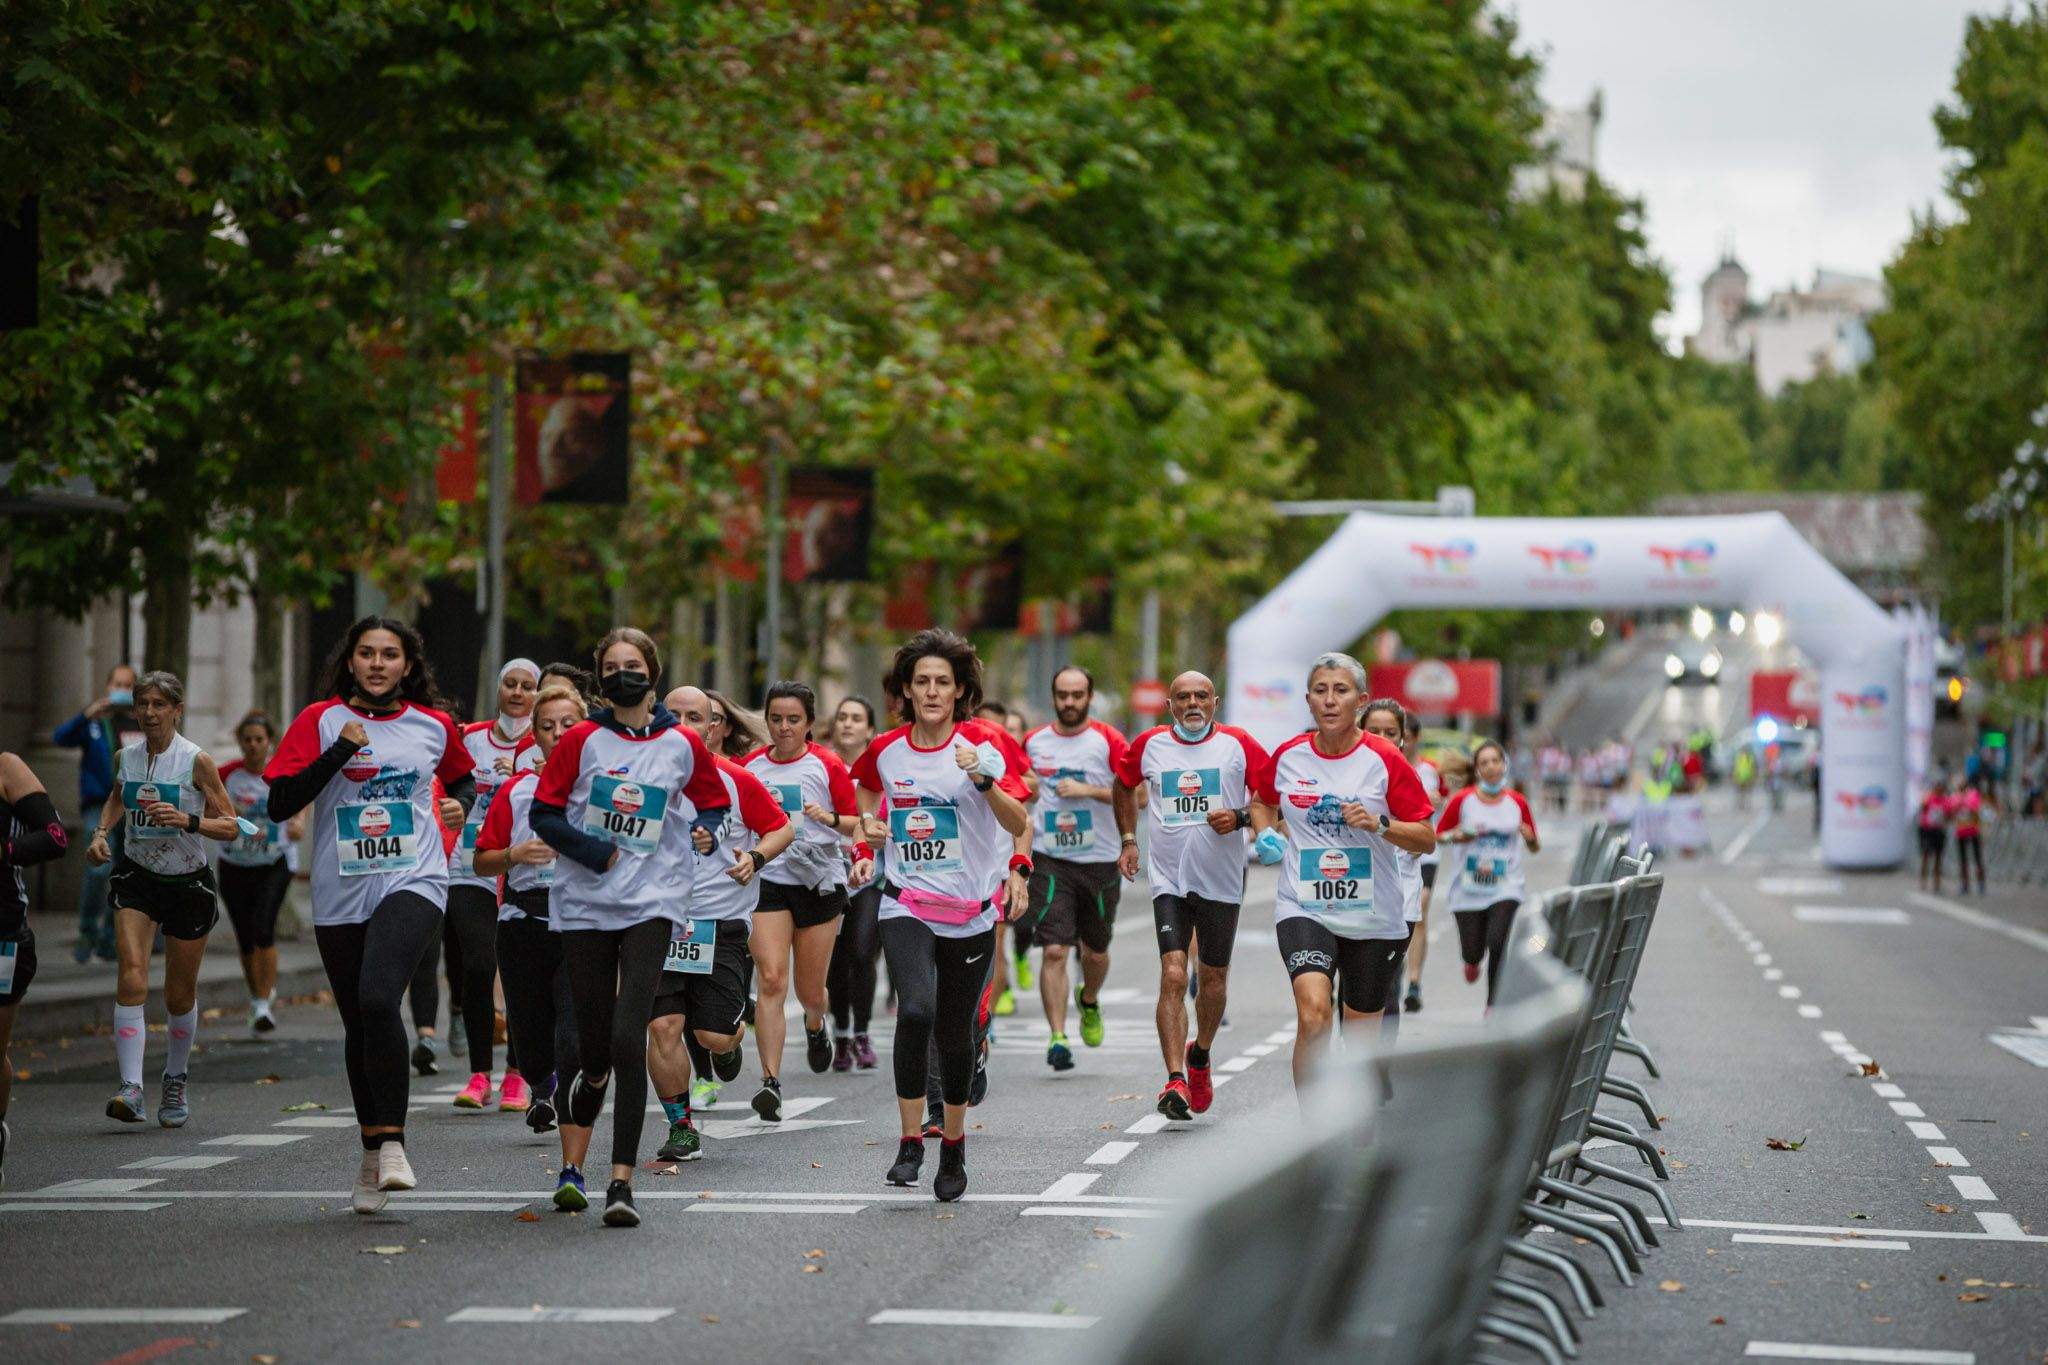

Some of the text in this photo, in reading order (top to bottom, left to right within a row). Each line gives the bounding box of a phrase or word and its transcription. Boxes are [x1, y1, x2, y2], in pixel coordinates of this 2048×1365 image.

[1173, 795, 1209, 814] 1075
[603, 811, 647, 838] 1047
[353, 836, 402, 860] 1044
[1055, 831, 1084, 846] 1037
[901, 840, 946, 862] 1032
[1312, 879, 1359, 900] 1062
